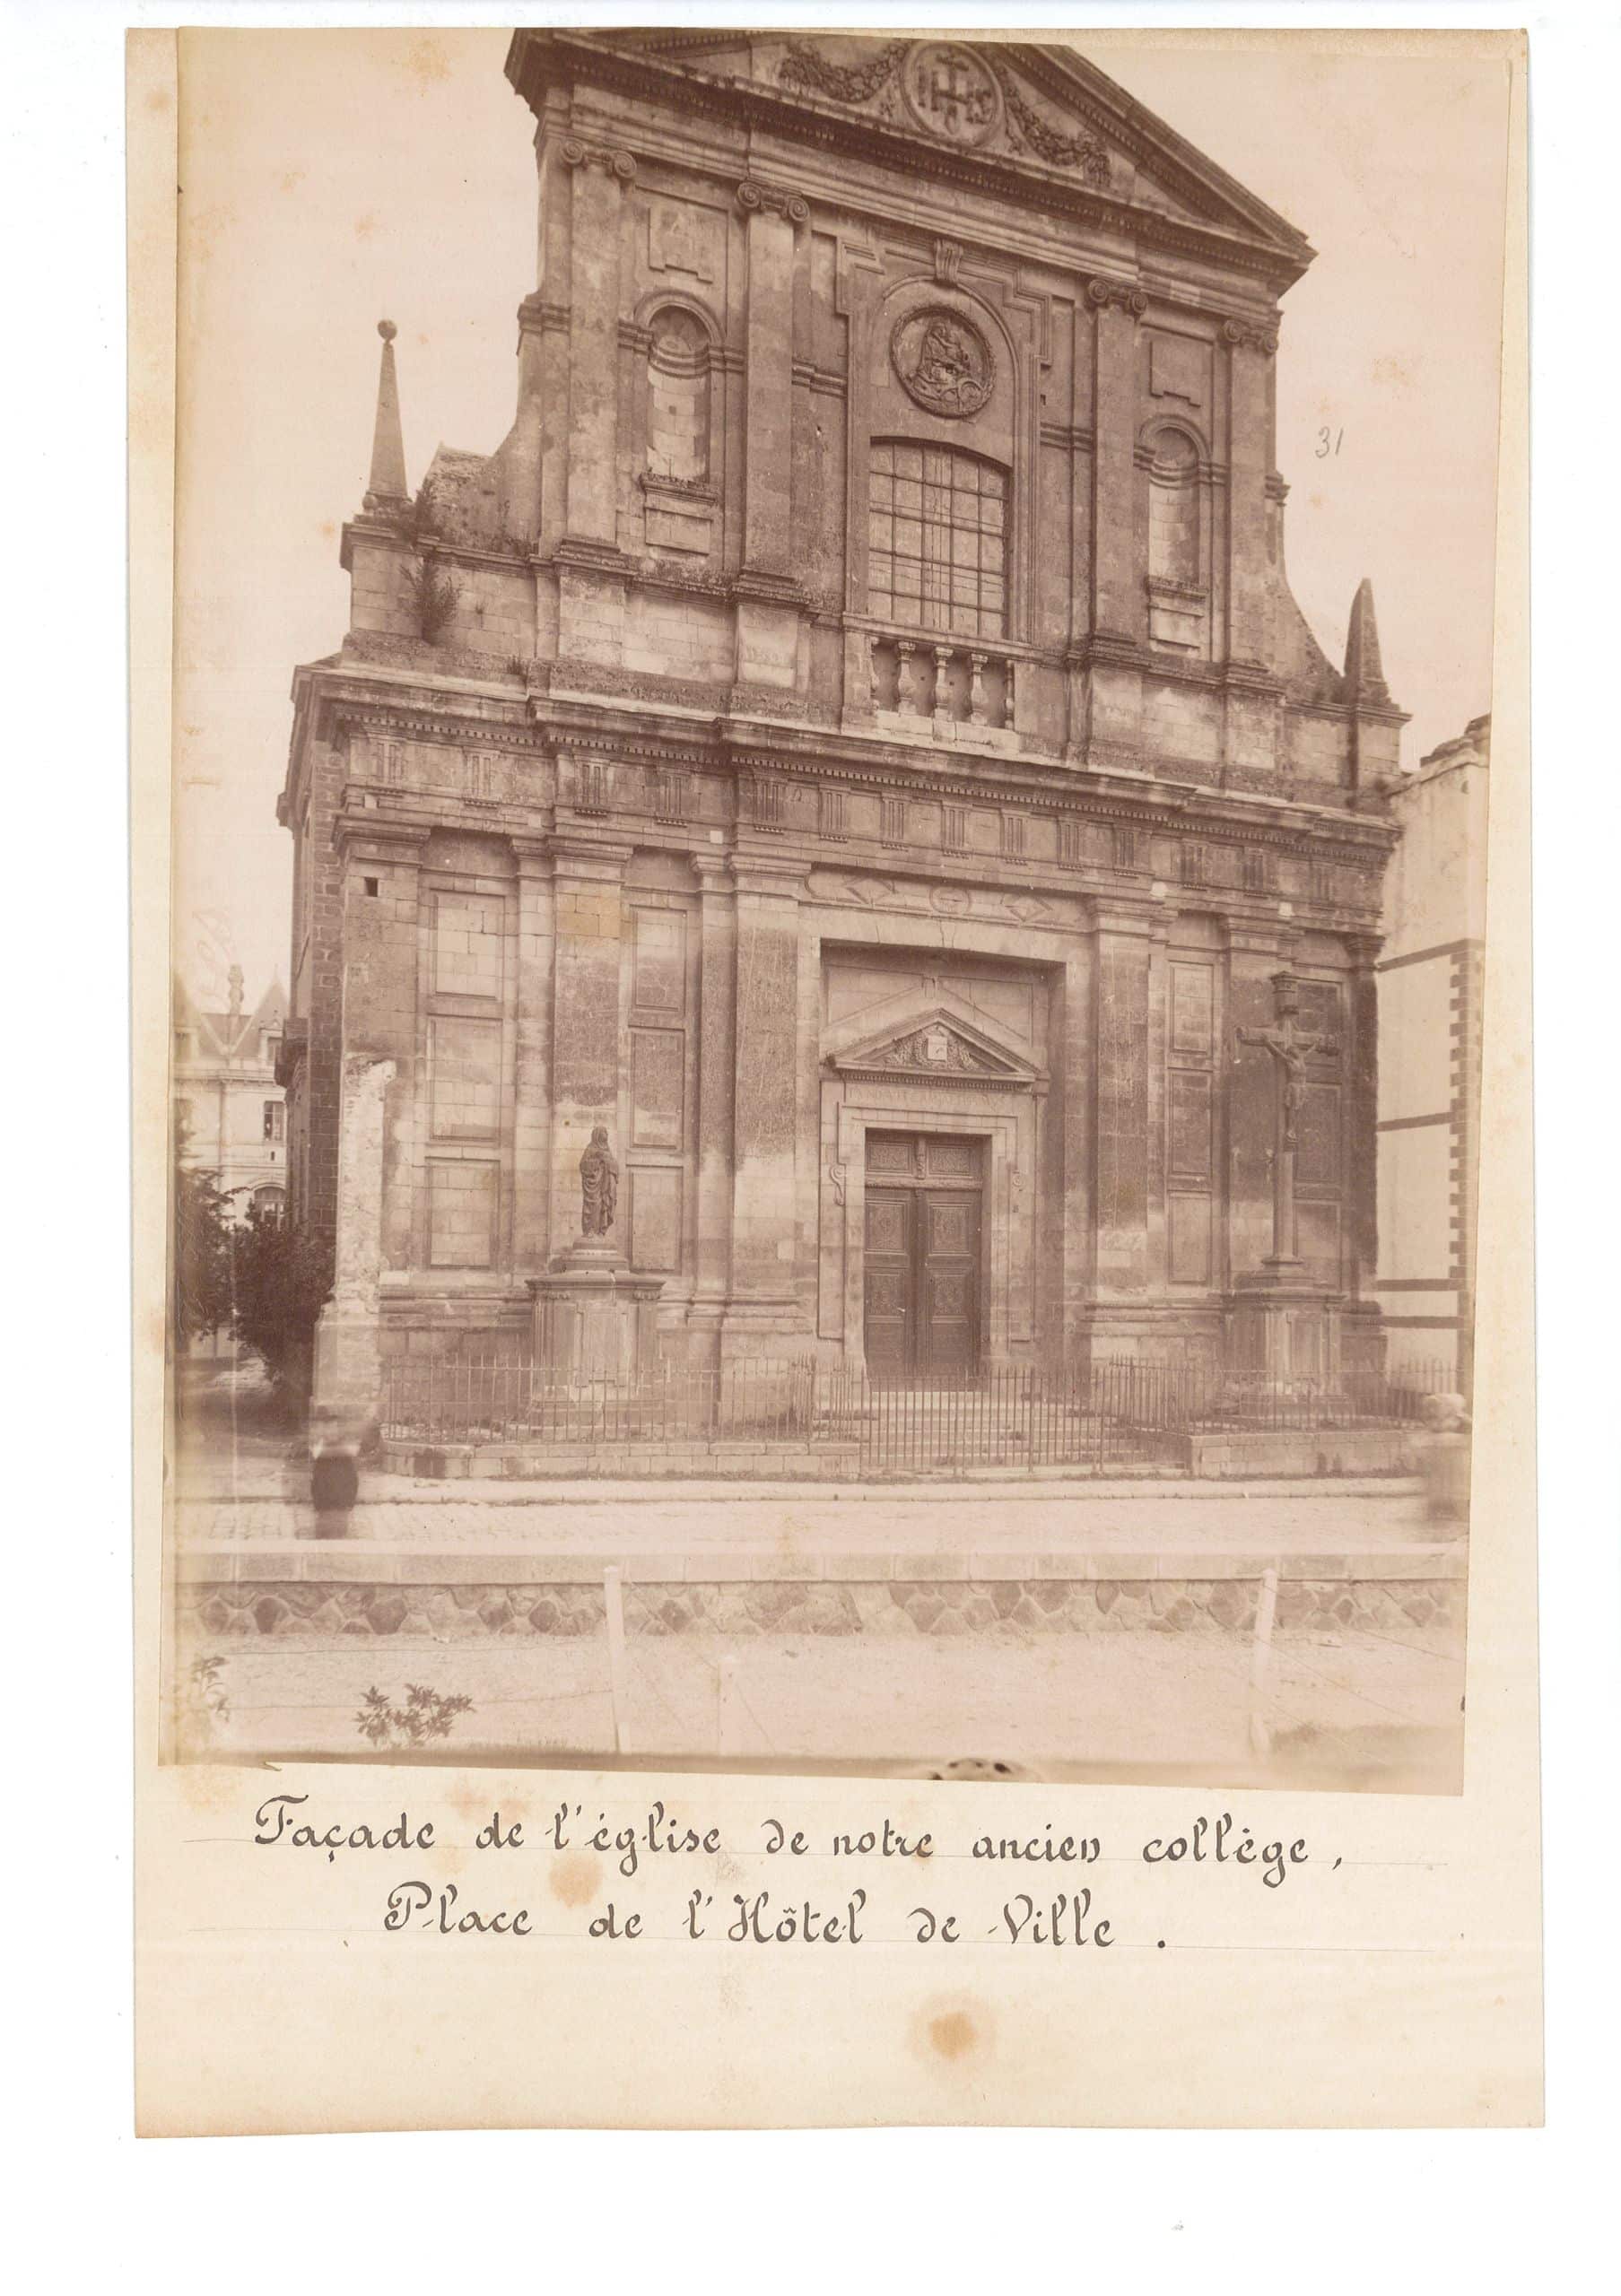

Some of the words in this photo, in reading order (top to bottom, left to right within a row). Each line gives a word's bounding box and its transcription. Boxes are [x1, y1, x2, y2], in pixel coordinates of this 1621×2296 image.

[1314, 425, 1344, 459] 31
[254, 1794, 436, 1863] Façade
[475, 1812, 525, 1849] de
[544, 1802, 722, 1877] l'église
[763, 1819, 810, 1856] de
[832, 1819, 935, 1858] notre
[972, 1823, 1102, 1864] ancien
[383, 1881, 533, 1935] Place
[588, 1903, 643, 1940] de
[909, 1908, 961, 1944] de
